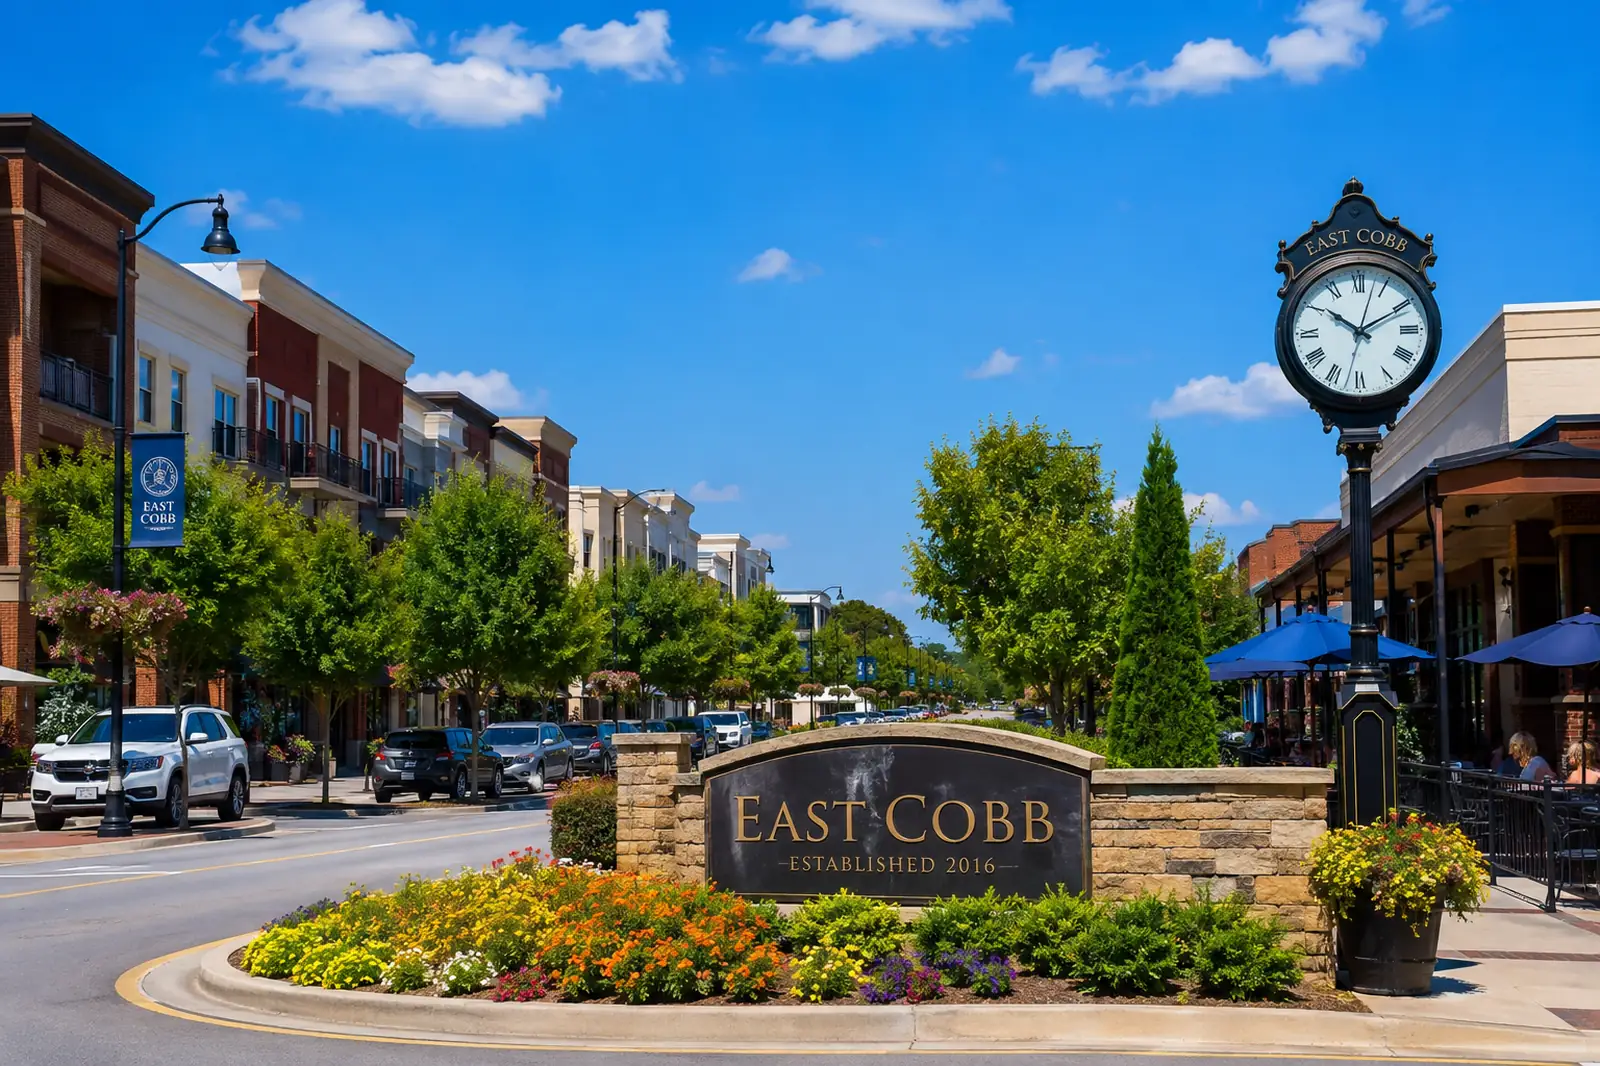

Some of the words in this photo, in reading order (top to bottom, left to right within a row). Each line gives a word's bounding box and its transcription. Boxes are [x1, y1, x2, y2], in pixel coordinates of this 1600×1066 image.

[1304, 229, 1351, 256] EAST
[1356, 228, 1409, 252] COBB
[143, 501, 175, 512] EAST
[140, 513, 176, 524] COBB
[733, 794, 867, 843] EAST
[884, 793, 1055, 845] COBB
[788, 856, 936, 873] ESTABLISHED
[946, 856, 996, 874] 2016
